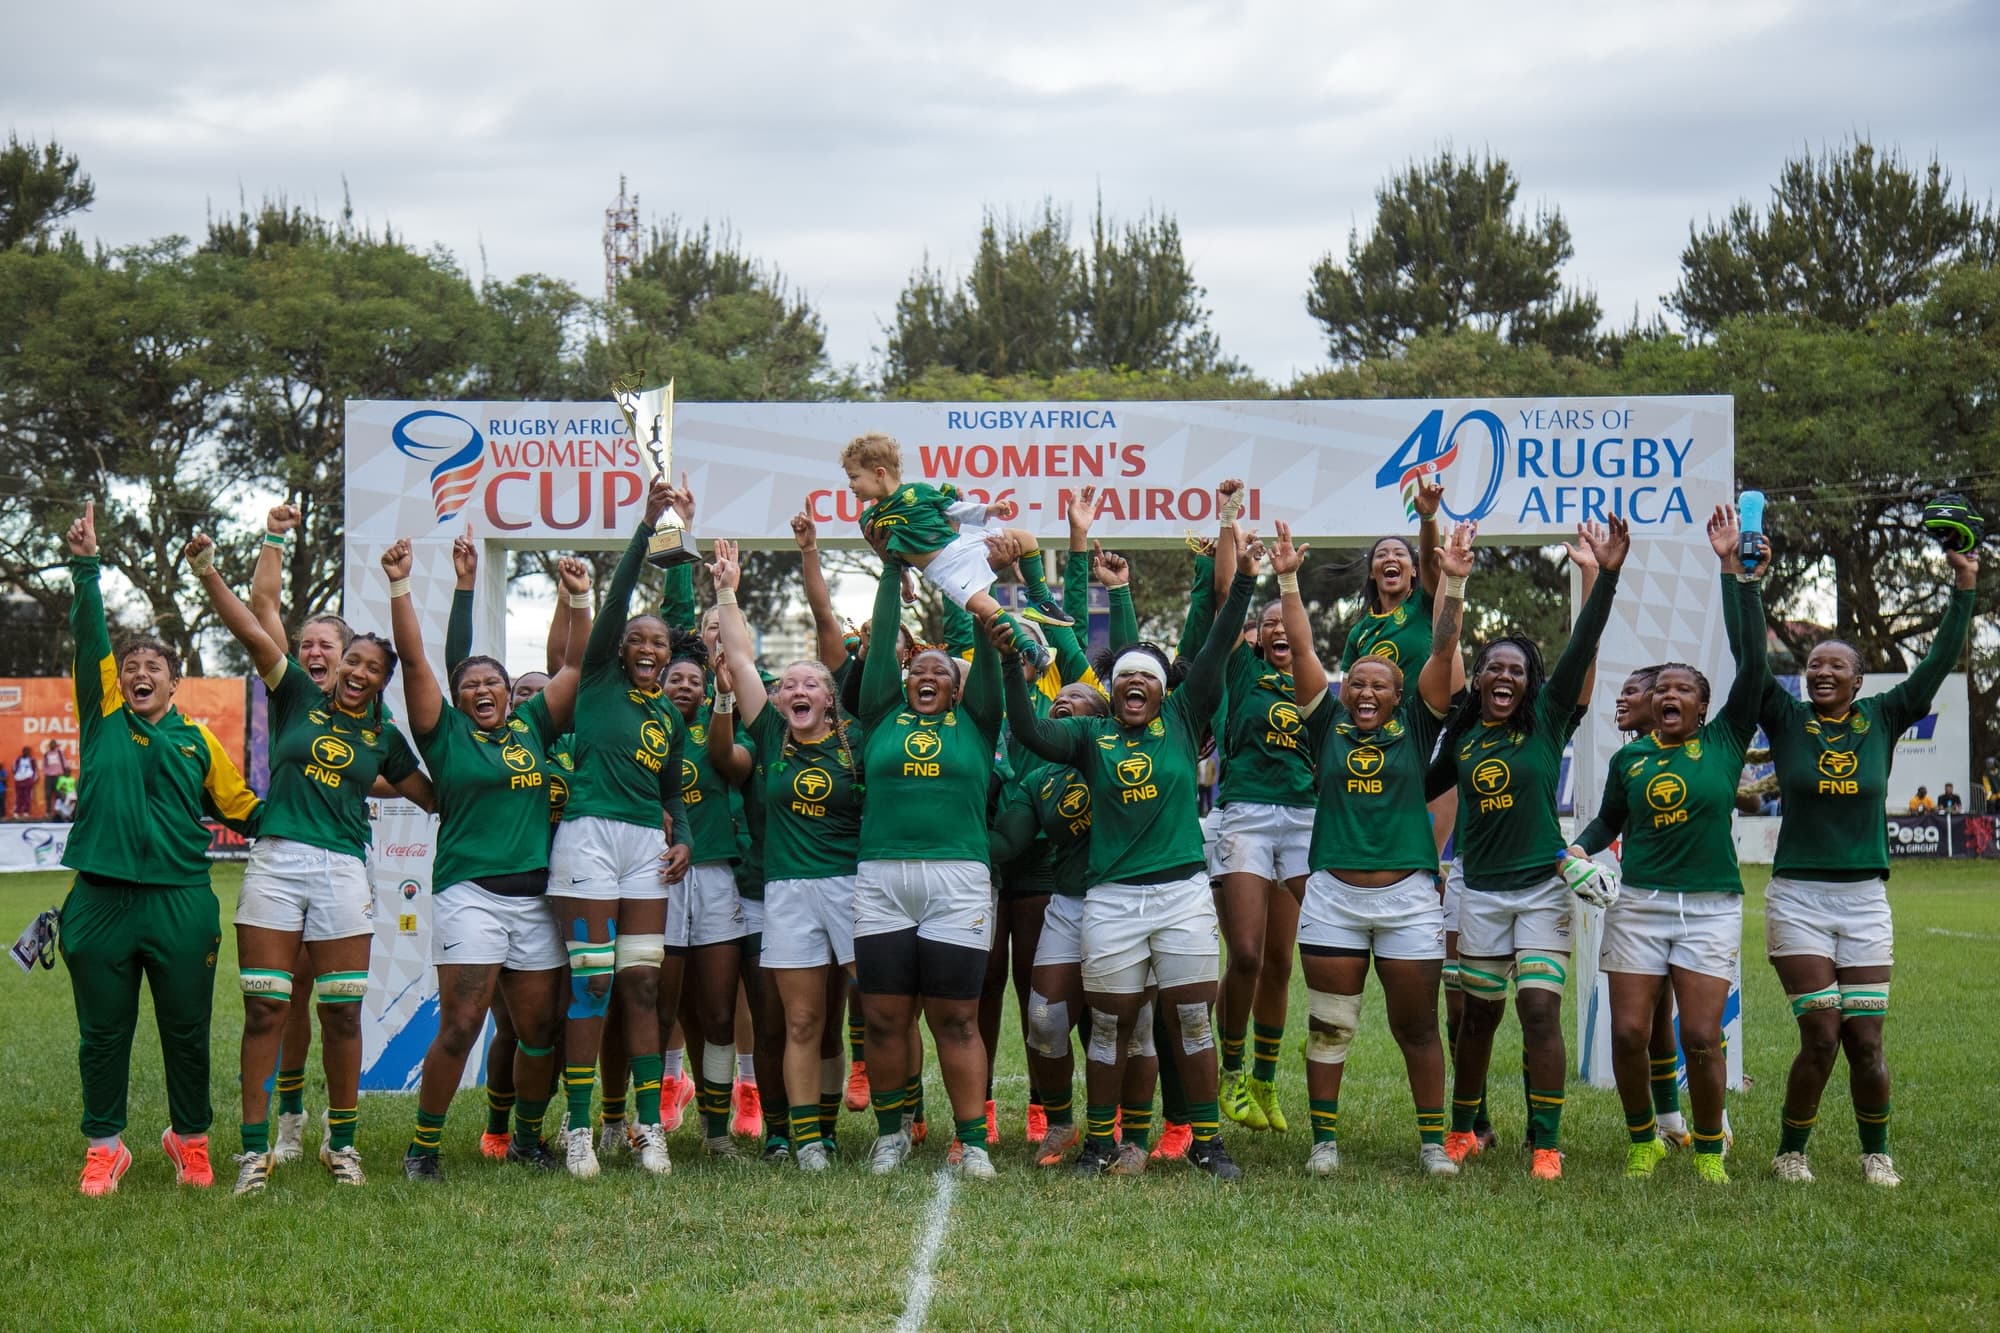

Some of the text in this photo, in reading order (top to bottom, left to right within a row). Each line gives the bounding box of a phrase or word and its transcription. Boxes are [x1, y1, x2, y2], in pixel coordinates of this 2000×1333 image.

[489, 419, 558, 435] RUGBY
[948, 410, 1117, 429] RUGBY AFRICA
[1519, 410, 1635, 430] YEARS OF
[490, 438, 640, 467] WOMEN'S
[919, 442, 1146, 478] WOMEN'S
[1518, 438, 1694, 479] RUGBY
[1375, 409, 1512, 523] 40
[484, 471, 643, 530] CUP
[809, 489, 878, 522] CU
[1518, 486, 1693, 523] AFRICA
[133, 734, 149, 746] FNB
[304, 764, 341, 788] FNB
[904, 762, 940, 777] FNB
[511, 772, 542, 790] FNB
[1347, 780, 1383, 793] FNB
[1818, 780, 1858, 795] FNB
[682, 790, 702, 804] NB
[1122, 784, 1158, 804] FNB
[1480, 794, 1514, 814] FNB
[792, 801, 826, 817] FNB
[1069, 810, 1092, 836] FN
[1654, 810, 1688, 829] FNB
